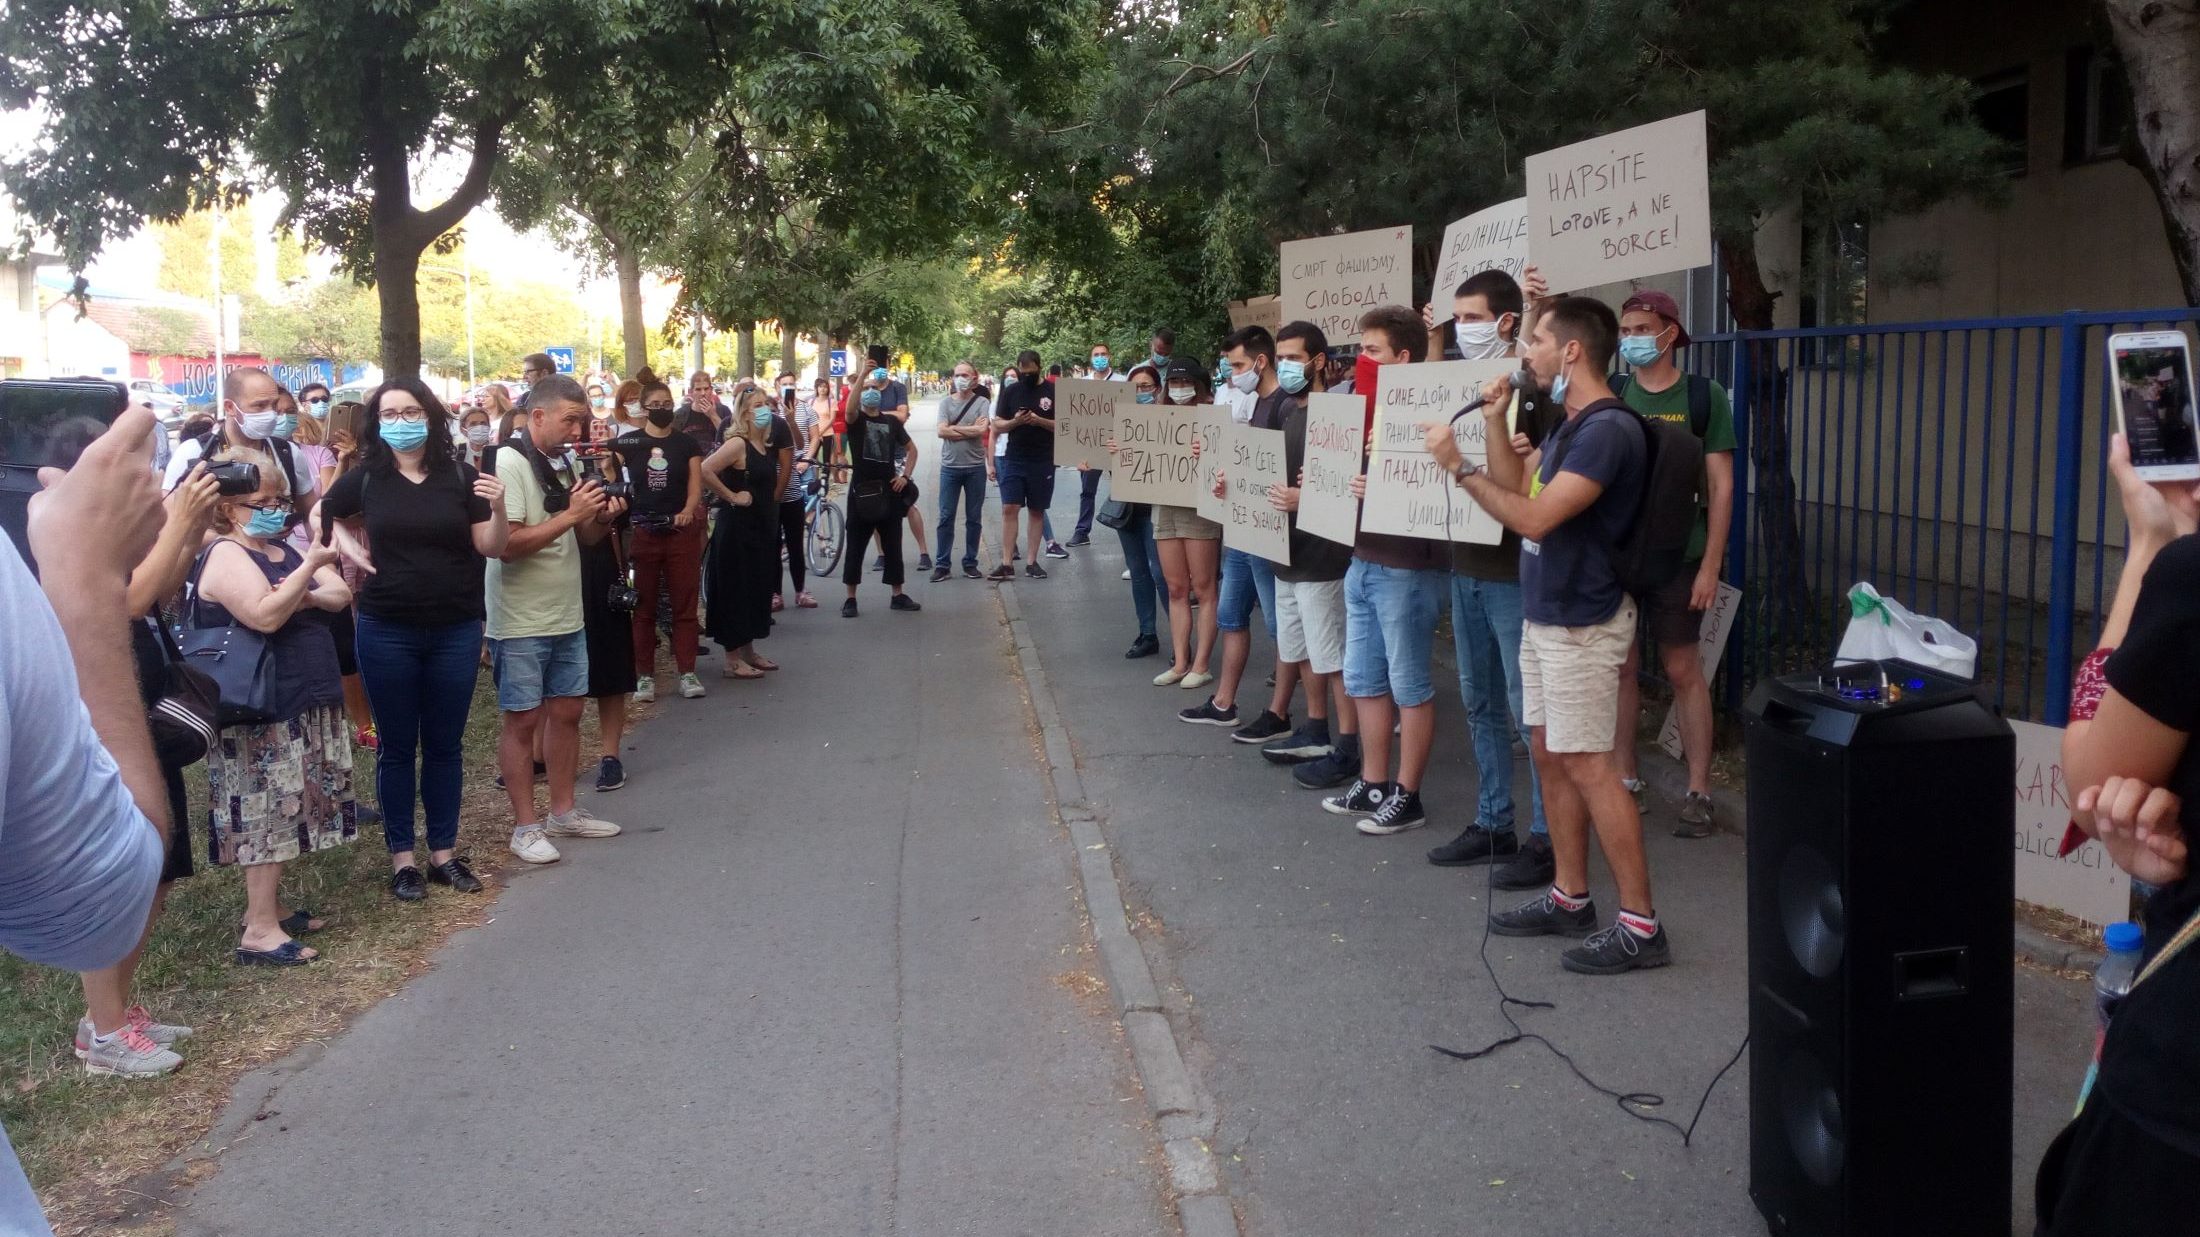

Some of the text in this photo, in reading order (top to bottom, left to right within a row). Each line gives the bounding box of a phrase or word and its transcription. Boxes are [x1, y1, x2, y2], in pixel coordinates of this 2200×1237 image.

[1549, 149, 1648, 201] HAPSITE
[1451, 215, 1528, 259] БОЛНИЦЕ
[1549, 193, 1672, 238] LOPOVE, A NE
[1601, 213, 1679, 260] BORCE!
[1292, 260, 1327, 280] СМРТ
[1305, 283, 1389, 310] СЛОБОДА
[1122, 412, 1199, 446] BOLNICE
